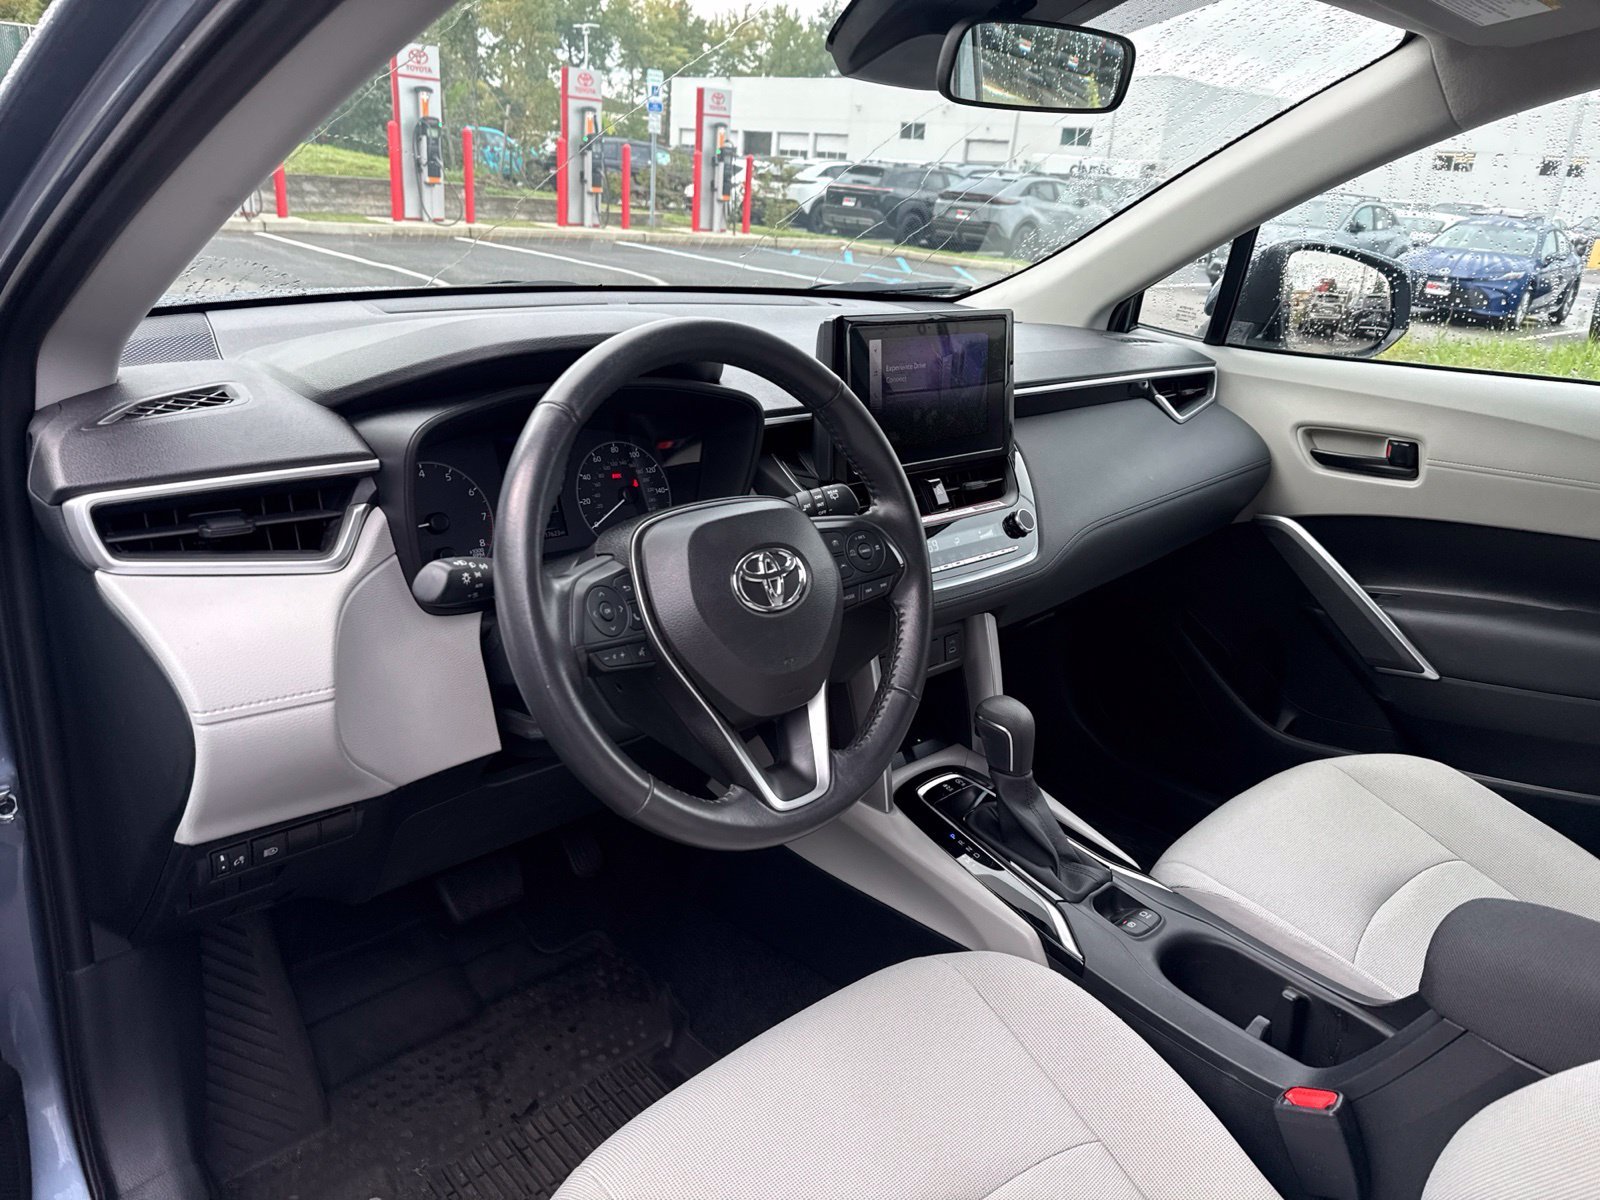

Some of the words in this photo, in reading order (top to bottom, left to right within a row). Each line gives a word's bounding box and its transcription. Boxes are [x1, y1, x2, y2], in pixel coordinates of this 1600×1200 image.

[406, 64, 433, 73] TOYOTA
[592, 455, 602, 463] 60
[629, 451, 640, 459] 100
[418, 469, 426, 478] 4
[645, 466, 657, 474] 120
[445, 473, 452, 482] 5
[468, 489, 475, 497] 6
[655, 486, 666, 494] 140
[480, 512, 487, 521] 7
[479, 538, 486, 547] 8
